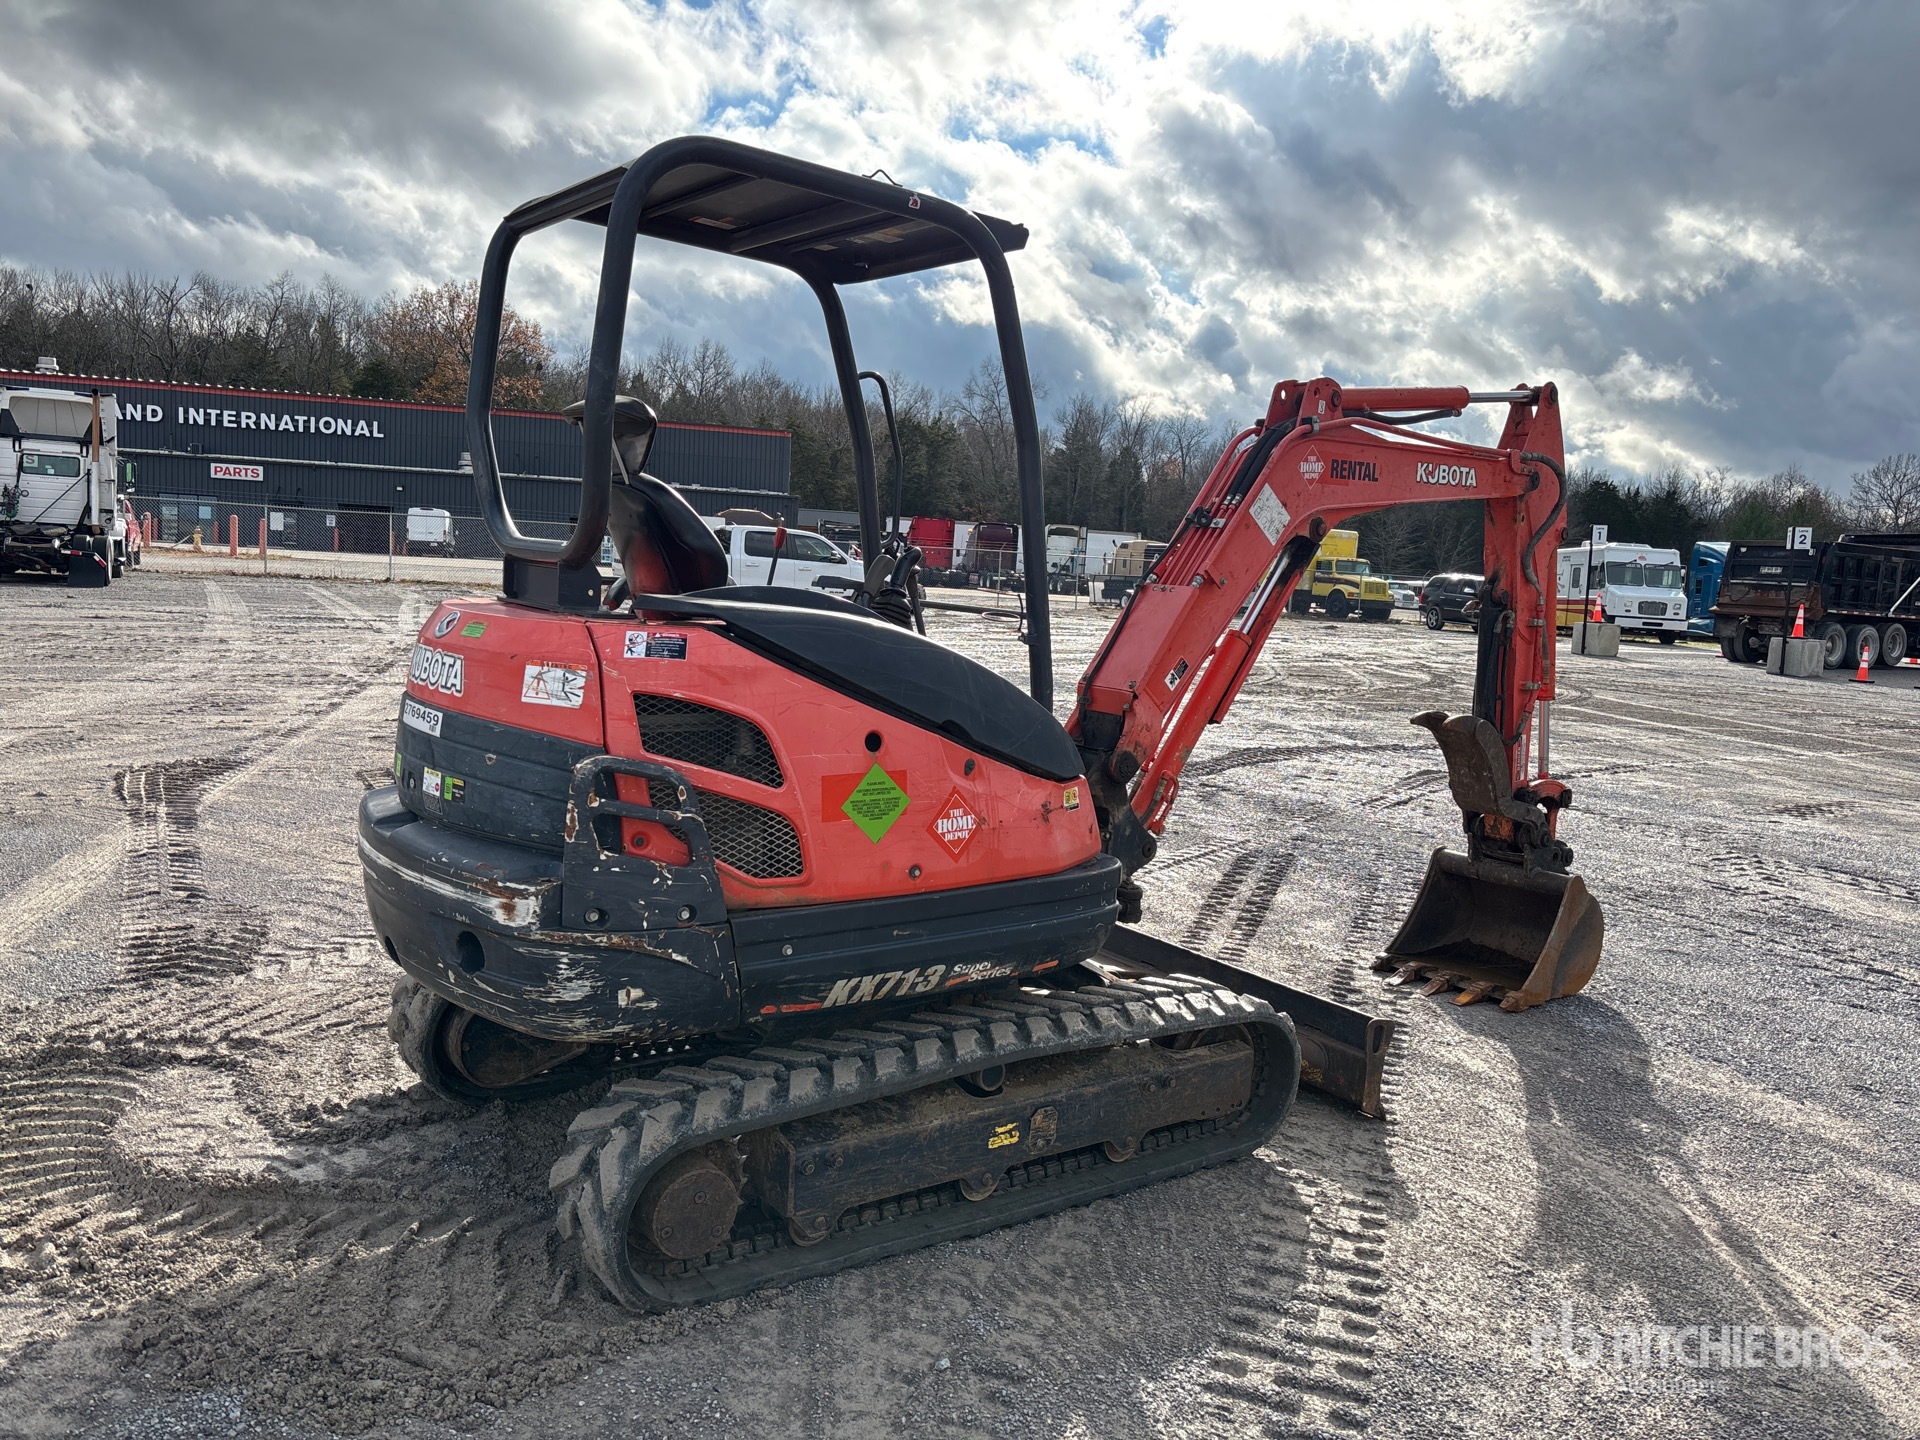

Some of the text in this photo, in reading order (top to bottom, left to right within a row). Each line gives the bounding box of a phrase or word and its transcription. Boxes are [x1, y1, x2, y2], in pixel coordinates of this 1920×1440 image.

[178, 406, 385, 438] INTERNATIONAL
[213, 465, 260, 478] PARTS
[1300, 462, 1323, 473] HOME
[1330, 459, 1378, 482] RENTAL
[1416, 461, 1477, 487] KUBOTA
[1597, 531, 1602, 541] 1
[1798, 534, 1807, 545] 2
[404, 702, 440, 726] 2769459
[949, 808, 964, 817] THE
[937, 814, 976, 833] HOME
[944, 830, 970, 841] DEPOT
[952, 962, 992, 975] Super
[968, 966, 1012, 982] Series
[821, 964, 946, 1009] KX71-3
